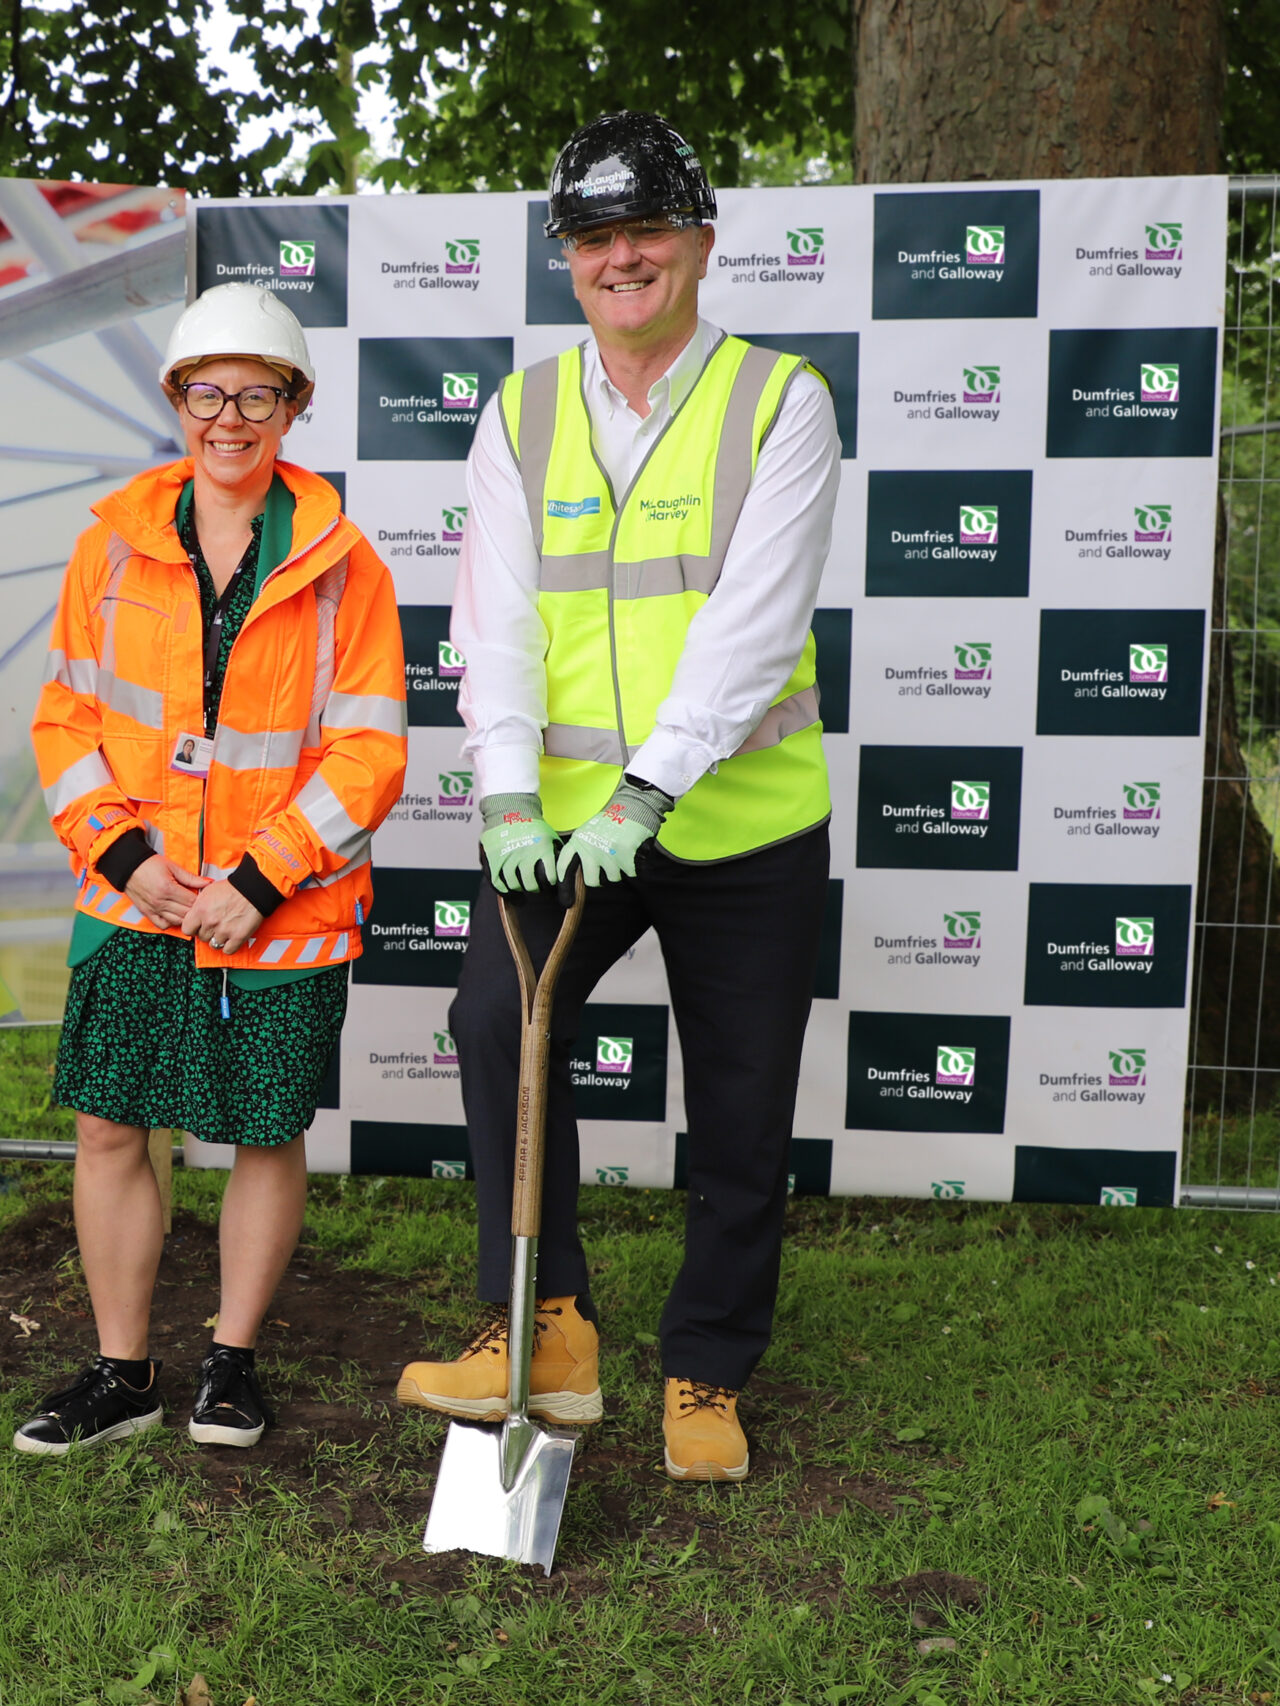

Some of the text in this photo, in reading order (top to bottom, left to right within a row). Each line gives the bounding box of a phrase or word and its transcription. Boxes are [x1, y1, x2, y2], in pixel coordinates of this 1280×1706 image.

[574, 170, 635, 190] McLaughlin
[582, 180, 626, 198] &Harvey
[718, 254, 781, 266] Dumfries
[898, 250, 961, 264] Dumfries
[1075, 246, 1138, 260] Dumfries
[216, 264, 274, 275] Dumfries
[381, 262, 439, 274] Dumfries
[911, 266, 1004, 282] and Galloway
[1088, 263, 1182, 279] and Galloway
[732, 269, 824, 284] and Galloway
[393, 277, 479, 291] and Galloway
[379, 396, 437, 407] Dumfries
[893, 390, 956, 403] Dumfries
[1072, 388, 1135, 402] Dumfries
[391, 410, 477, 425] and Galloway
[906, 406, 1000, 422] and Galloway
[1085, 404, 1178, 420] and Galloway
[378, 530, 436, 542] Dumfries
[891, 530, 954, 544] Dumfries
[1064, 528, 1128, 542] Dumfries
[390, 545, 460, 557] and Gallow
[904, 546, 998, 562] and Galloway
[1078, 545, 1171, 561] and Galloway
[406, 664, 434, 676] fries
[884, 666, 948, 680] Dumfries
[1061, 668, 1124, 682] Dumfries
[412, 678, 462, 690] Gallow
[898, 683, 991, 699] and Galloway
[1074, 684, 1168, 700] and Galloway
[397, 794, 432, 805] fries
[412, 809, 472, 823] Galloway
[882, 805, 945, 818] Dumfries
[1053, 806, 1116, 819] Dumfries
[895, 822, 988, 837] and Galloway
[1066, 822, 1160, 838] and Galloway
[263, 834, 300, 870] PULSAR
[371, 924, 429, 936] Dumfries
[383, 939, 469, 954] and Galloway
[873, 934, 936, 948] Dumfries
[1047, 942, 1110, 956] Dumfries
[886, 951, 980, 967] and Galloway
[1060, 958, 1154, 974] and Galloway
[370, 1052, 428, 1064] Dumfries
[569, 1058, 591, 1070] ries
[382, 1067, 460, 1079] and Gallowa
[868, 1068, 929, 1082] Dumfries
[1039, 1072, 1102, 1086] Dumfries
[571, 1073, 630, 1090] Galloway
[880, 1084, 973, 1103] and Galloway
[1052, 1089, 1146, 1105] and Galloway
[521, 1086, 530, 1135] JACKSON
[519, 1148, 528, 1181] SPEAR
